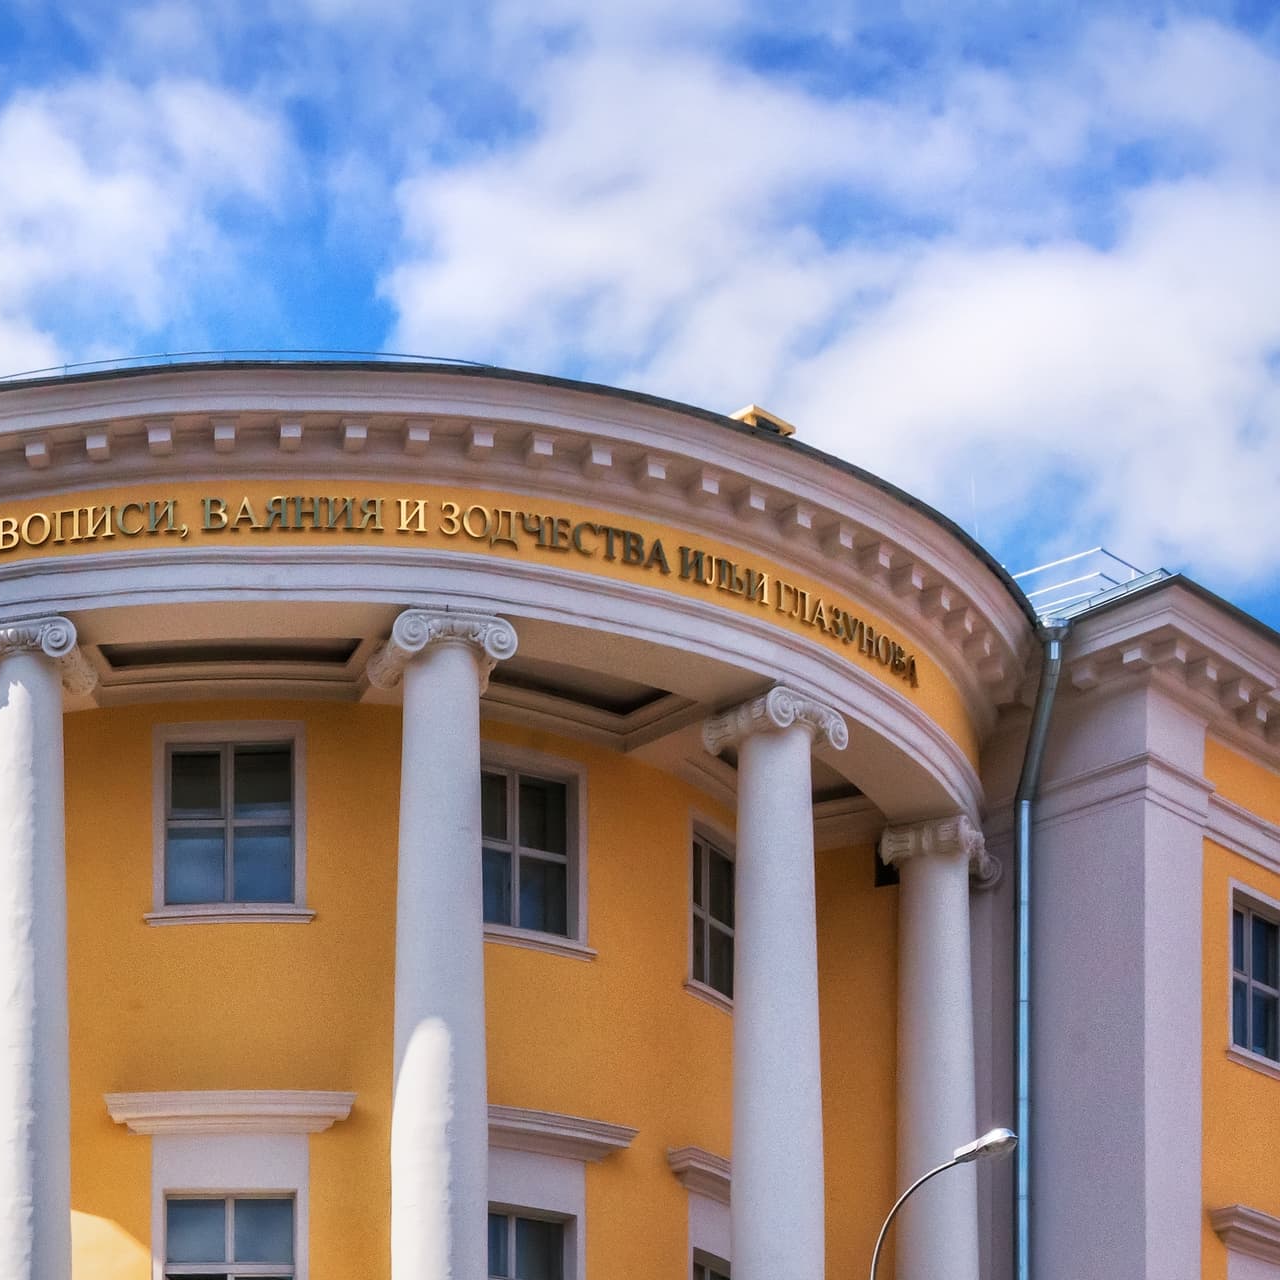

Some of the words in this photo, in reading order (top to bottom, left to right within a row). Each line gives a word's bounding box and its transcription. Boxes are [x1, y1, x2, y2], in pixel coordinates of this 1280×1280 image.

[200, 495, 385, 531] ВАЯНИЯ
[396, 498, 429, 533] И
[439, 501, 671, 575] ЗОДЧЕСТВА
[678, 546, 770, 605] ИЛЬИ
[774, 579, 919, 689] ГЛАЗУНОВА
